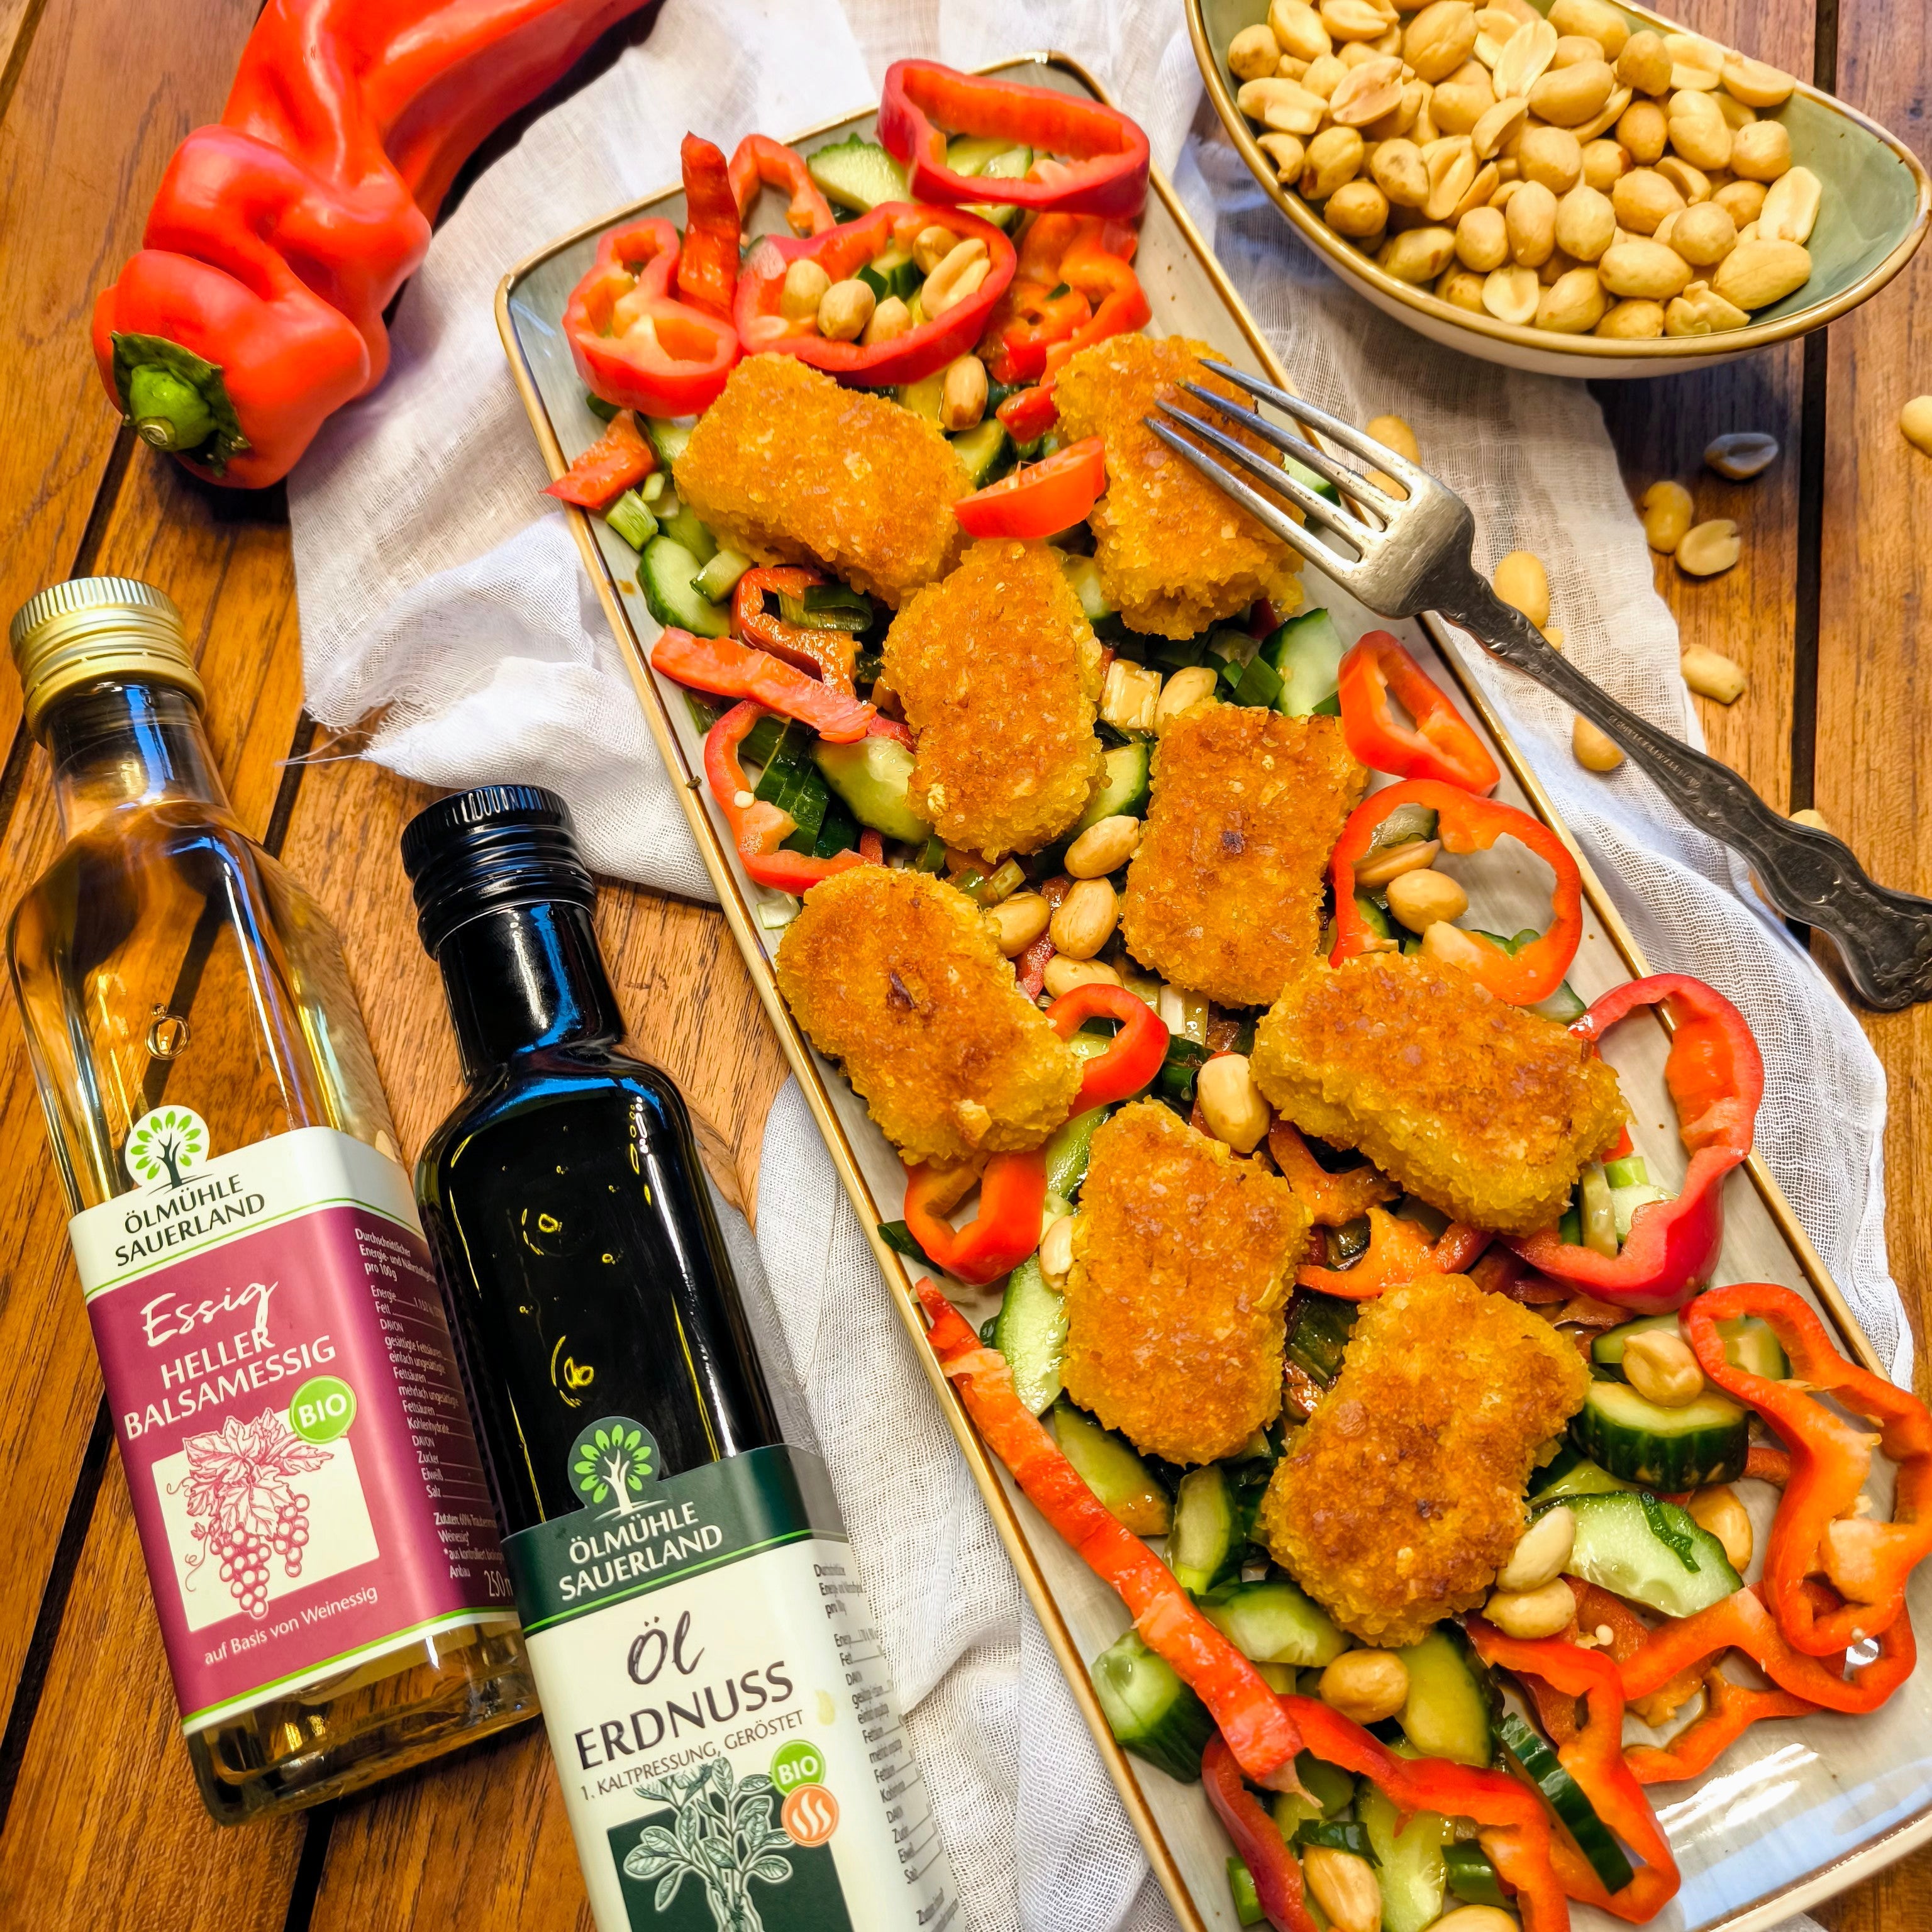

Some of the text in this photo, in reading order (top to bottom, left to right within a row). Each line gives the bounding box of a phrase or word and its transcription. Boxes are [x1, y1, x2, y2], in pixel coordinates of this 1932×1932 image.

[115, 1194, 265, 1267] SAUERLAND
[125, 1174, 243, 1234] ÖLMÜHLE
[364, 1262, 379, 1275] pro
[140, 1280, 279, 1347] Essig
[375, 1301, 391, 1314] Fett
[379, 1318, 404, 1332] DAVON
[124, 1335, 336, 1441] BALSAMESSIG
[160, 1328, 276, 1390] HELLER
[389, 1350, 414, 1365] einfach
[297, 1394, 347, 1429] BIO
[416, 1450, 439, 1463] Zucker
[426, 1484, 441, 1498] Salz
[559, 1524, 723, 1601] SAUERLAND
[569, 1501, 699, 1564] ÖLMÜHLE
[484, 1570, 506, 1597] 250
[204, 1587, 379, 1666] auf Basis von Weinessig
[627, 1611, 705, 1685] Öl
[574, 1660, 794, 1770] ERDNUSS
[580, 1709, 804, 1802] 1. KALTPRESSUNG, GERÖSTET
[778, 1755, 818, 1786] BIO
